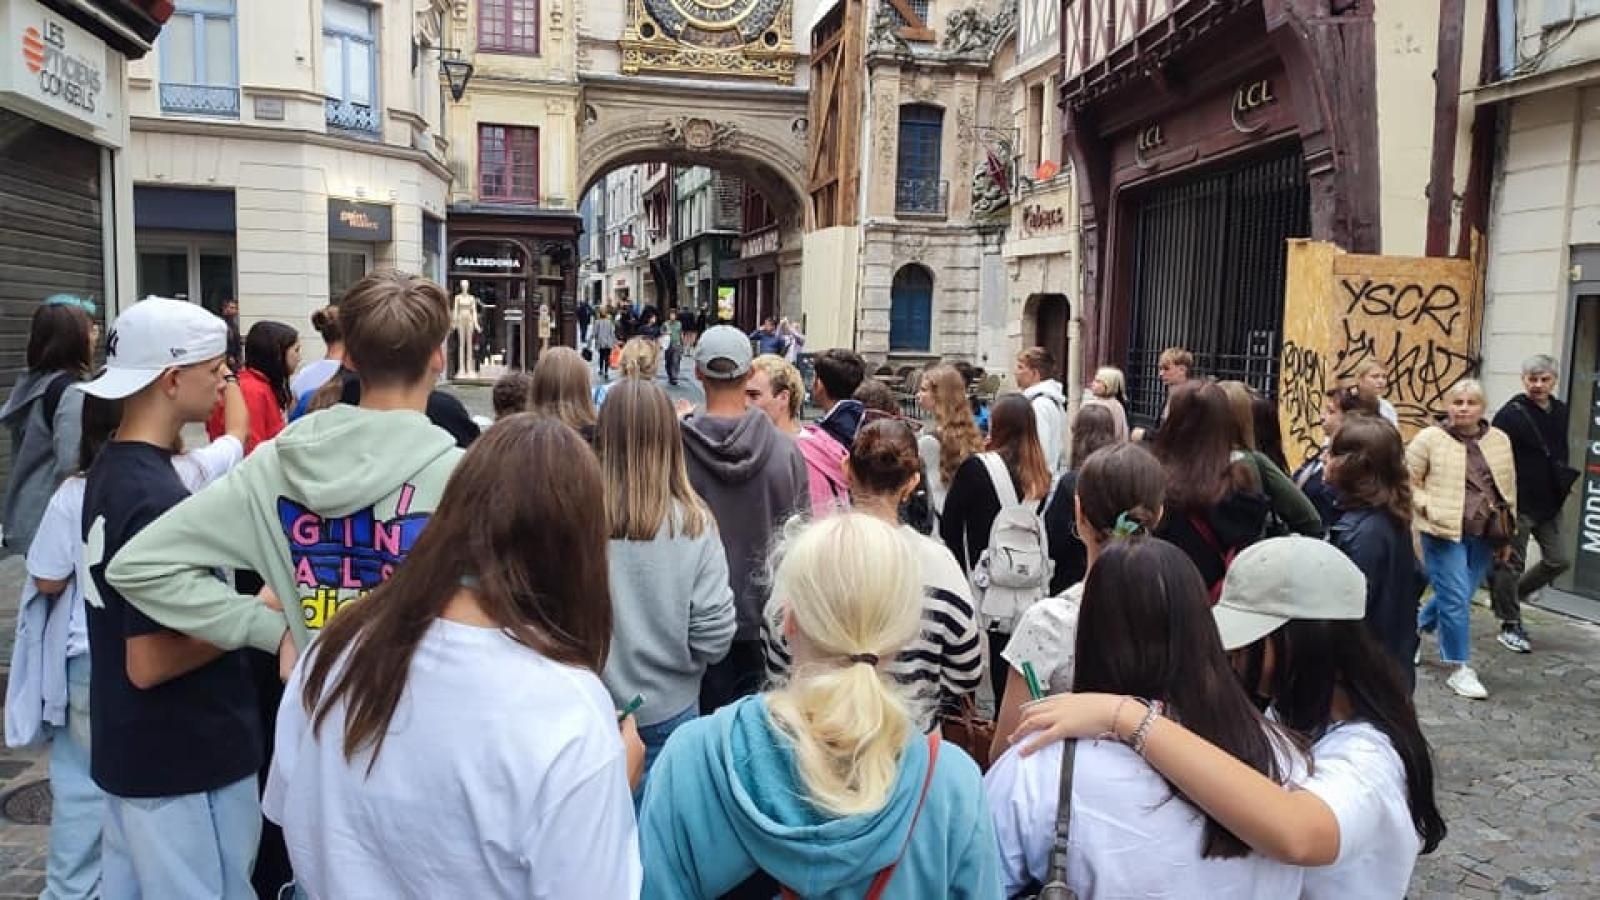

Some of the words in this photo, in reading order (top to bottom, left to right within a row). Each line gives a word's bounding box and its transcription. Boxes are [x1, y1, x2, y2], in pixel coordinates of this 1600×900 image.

[42, 19, 65, 49] LES
[1237, 79, 1274, 110] LCL
[1138, 125, 1162, 150] LCL
